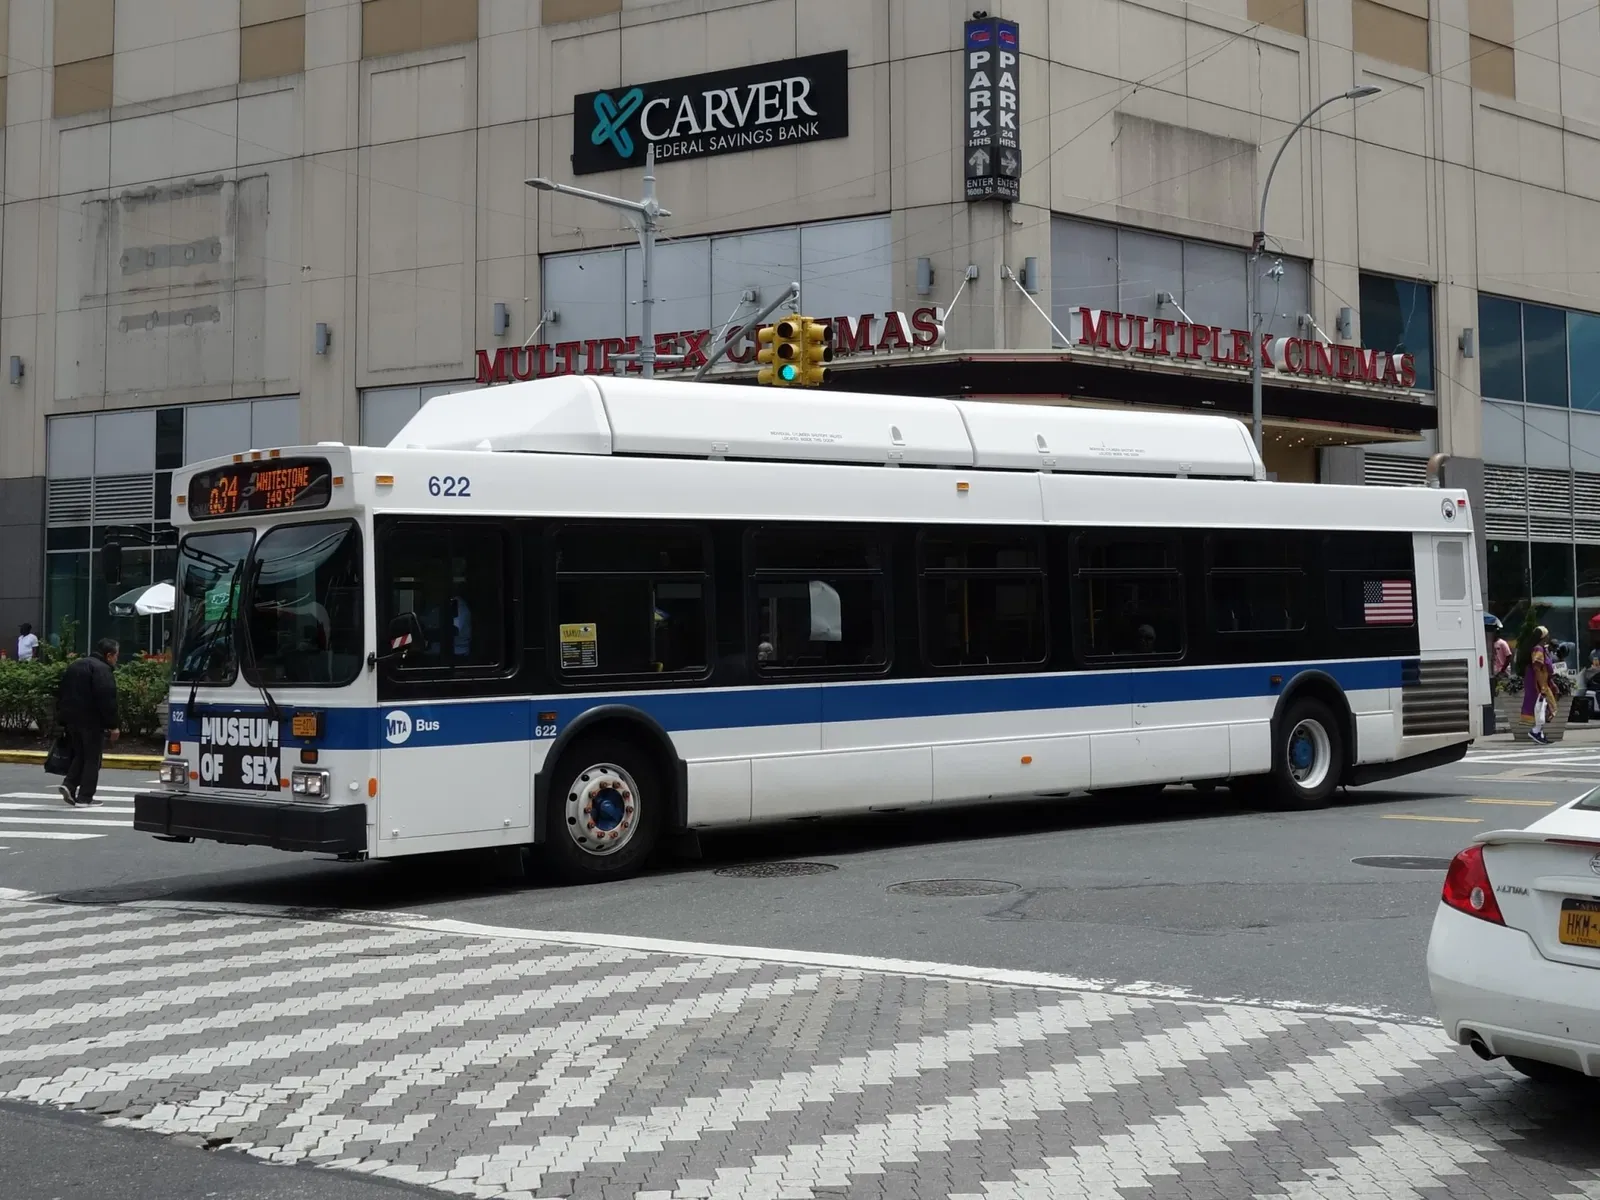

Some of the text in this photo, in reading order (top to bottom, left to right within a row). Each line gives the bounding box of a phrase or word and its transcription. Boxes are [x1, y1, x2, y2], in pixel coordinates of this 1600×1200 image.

[969, 51, 991, 128] PARK
[998, 51, 1016, 130] PARK
[640, 76, 817, 140] CARVER
[655, 121, 820, 159] EDERAL SAVINGS BANK
[969, 137, 991, 147] HRS
[973, 130, 988, 138] 24
[999, 137, 1017, 148] HRS
[1002, 130, 1014, 139] 24
[967, 177, 993, 188] ENTER
[997, 177, 1018, 189] ENTER
[476, 329, 712, 383] MULTIPLEX
[1282, 336, 1416, 388] CINEMAS
[256, 466, 310, 492] WHITESTONE
[428, 476, 471, 497] 622
[284, 489, 296, 507] ST
[172, 711, 184, 722] 622
[416, 719, 440, 732] Bus
[201, 717, 279, 748] MUSEUM
[535, 725, 557, 737] 622
[201, 753, 279, 786] OF SEX
